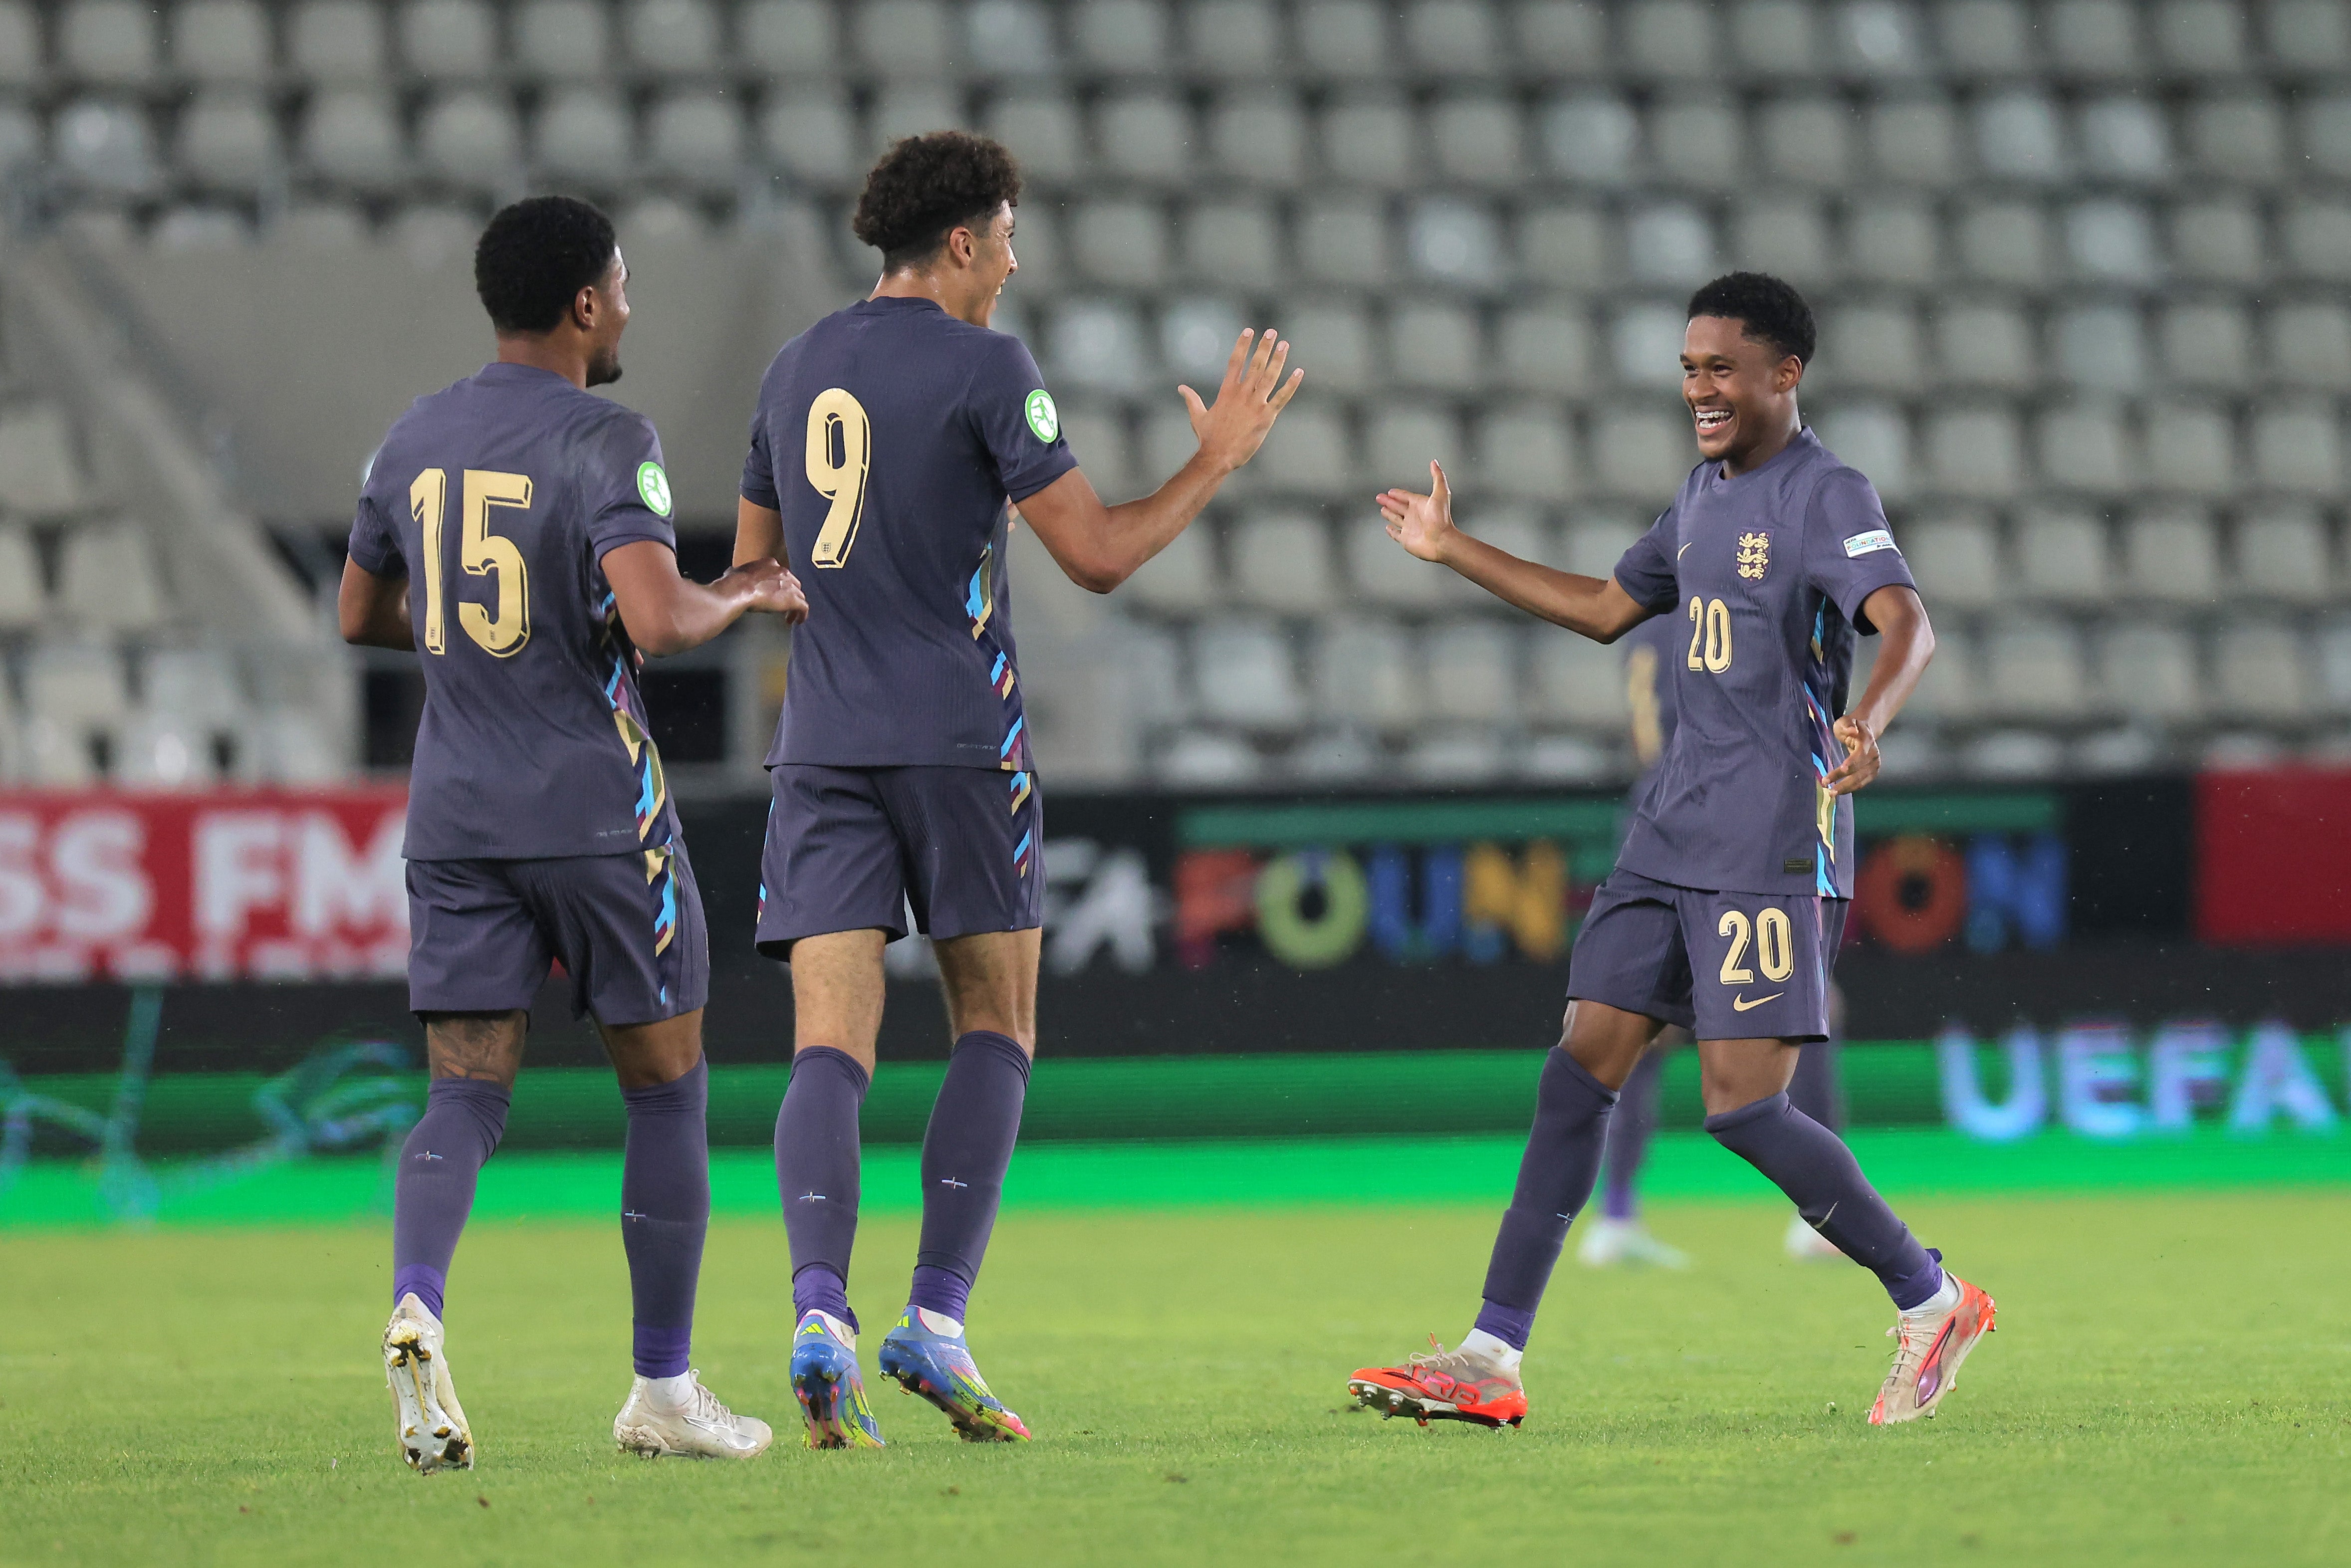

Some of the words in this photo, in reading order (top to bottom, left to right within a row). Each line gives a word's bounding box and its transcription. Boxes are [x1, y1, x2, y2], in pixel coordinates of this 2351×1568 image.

[805, 387, 871, 569] 9
[410, 467, 533, 658] 15
[1847, 537, 1890, 550] FOUNDATION
[1687, 596, 1732, 674] 20
[196, 812, 409, 934] FM
[1718, 907, 1795, 985] 20
[1937, 1020, 2338, 1141] UEFA
